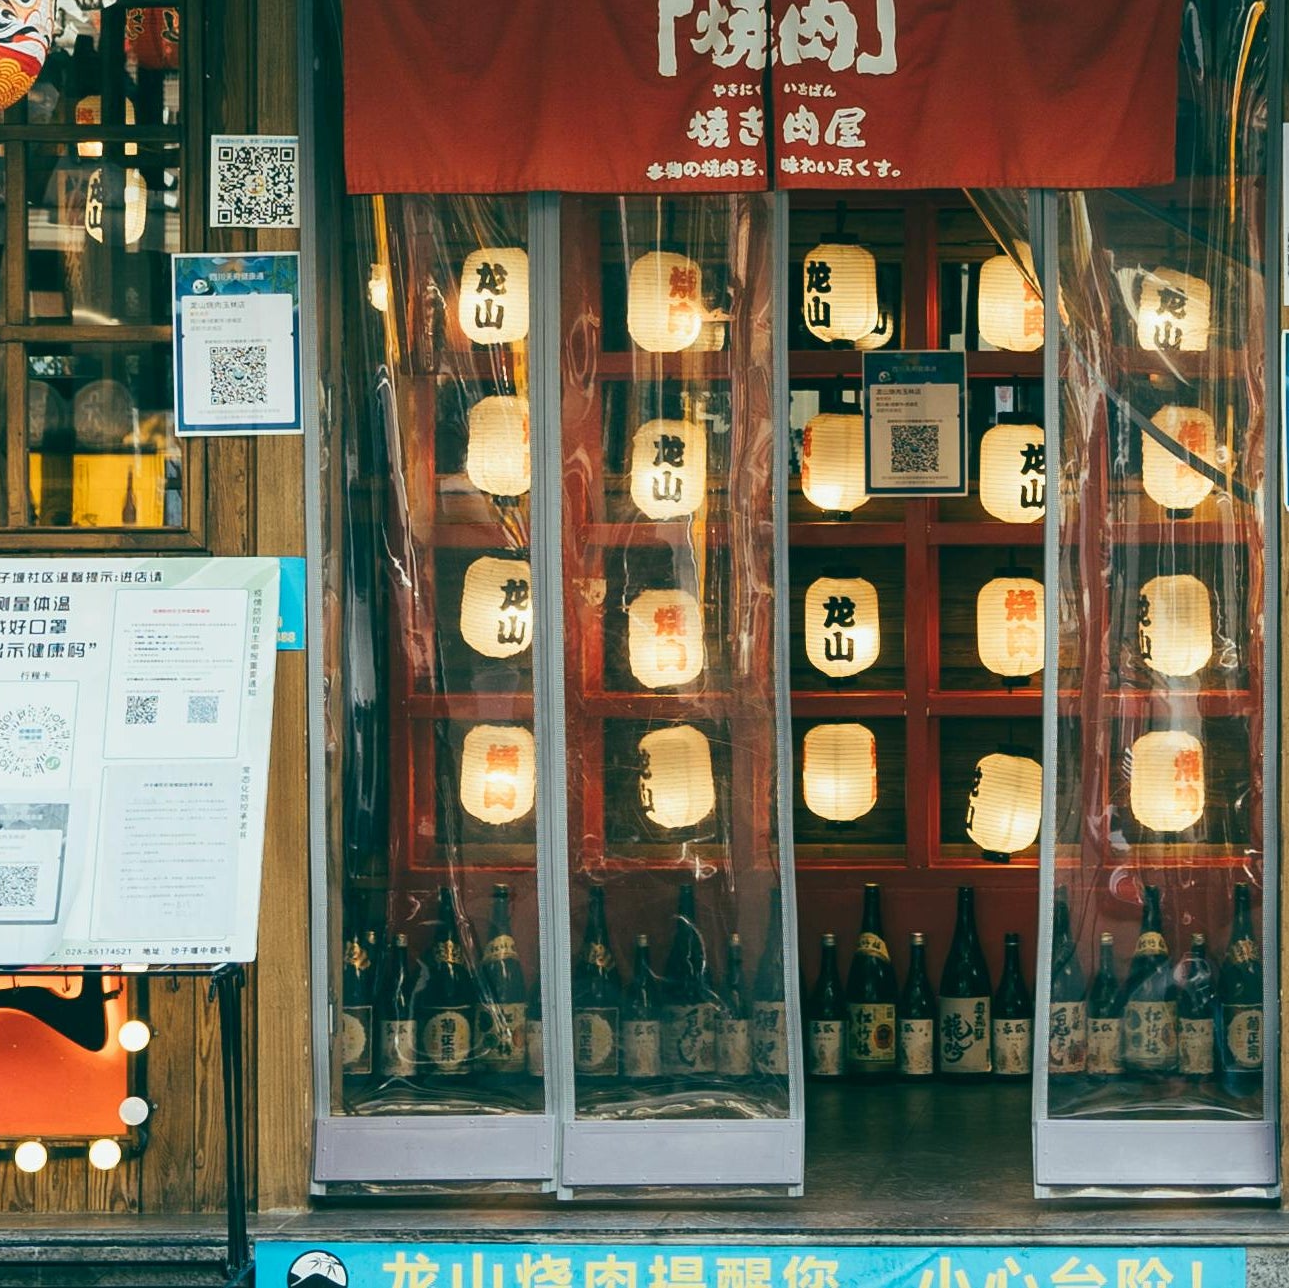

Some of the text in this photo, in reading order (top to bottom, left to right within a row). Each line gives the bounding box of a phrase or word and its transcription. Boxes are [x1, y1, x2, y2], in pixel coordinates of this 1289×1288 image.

[474, 261, 508, 331] 龙山
[806, 260, 833, 330] 龙山
[651, 433, 687, 505] 龙山
[497, 578, 532, 647] 龙山
[824, 595, 857, 664] 龙山
